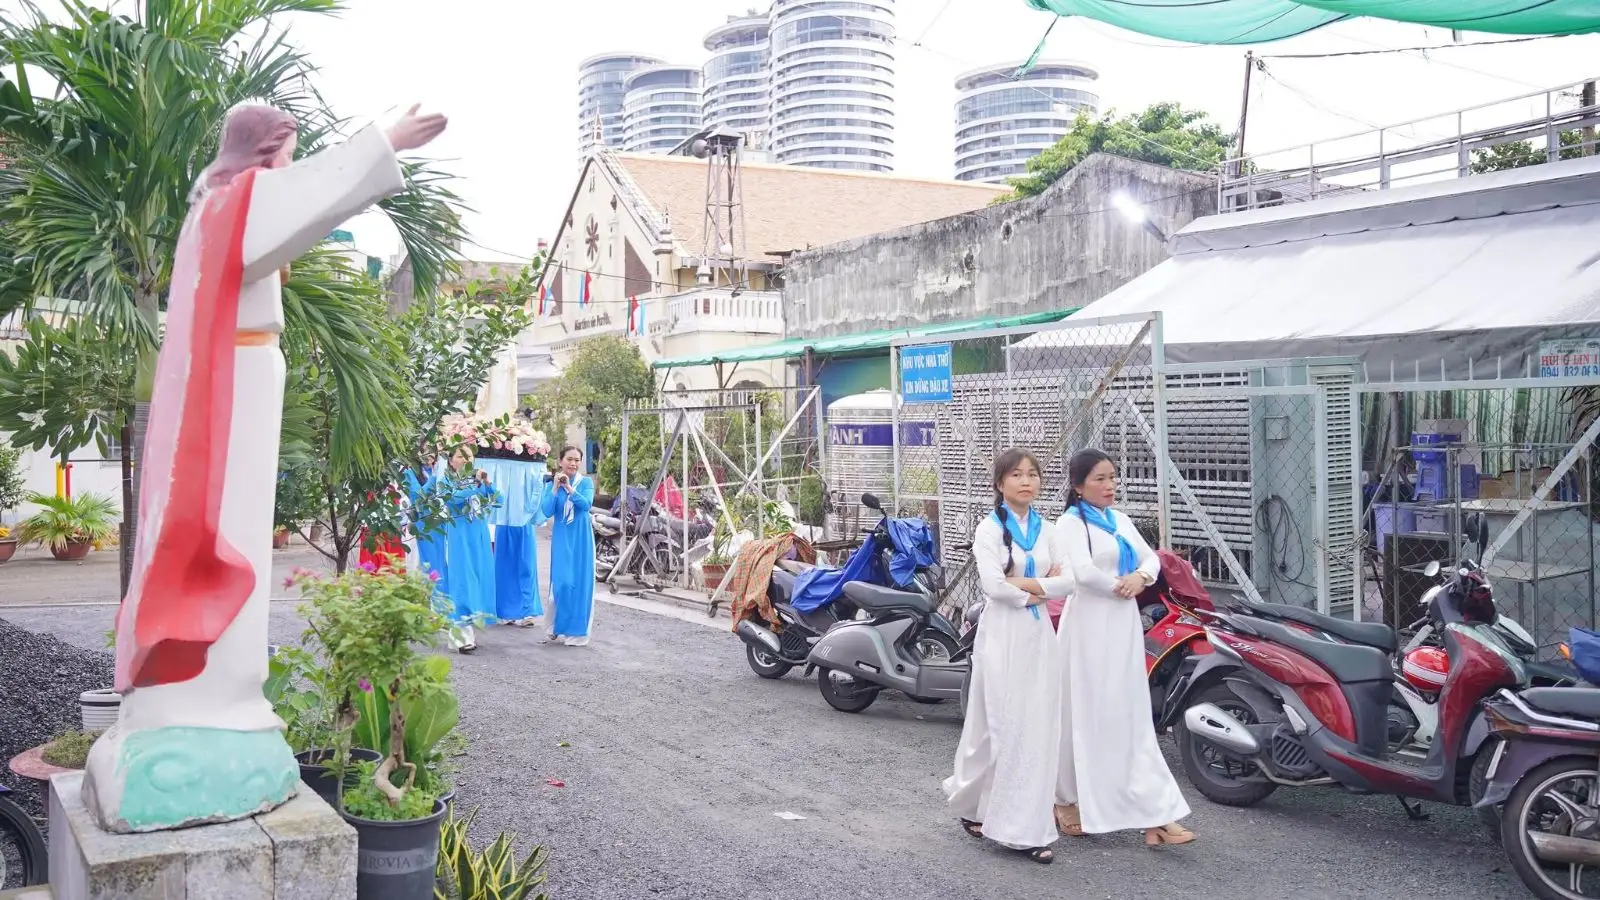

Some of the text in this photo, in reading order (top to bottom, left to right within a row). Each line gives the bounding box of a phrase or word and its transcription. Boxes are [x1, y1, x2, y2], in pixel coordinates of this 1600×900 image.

[903, 350, 949, 370] KHU VỰC NHÀ THỜ
[905, 377, 949, 396] XIN ĐỪNG ĐẬU XE
